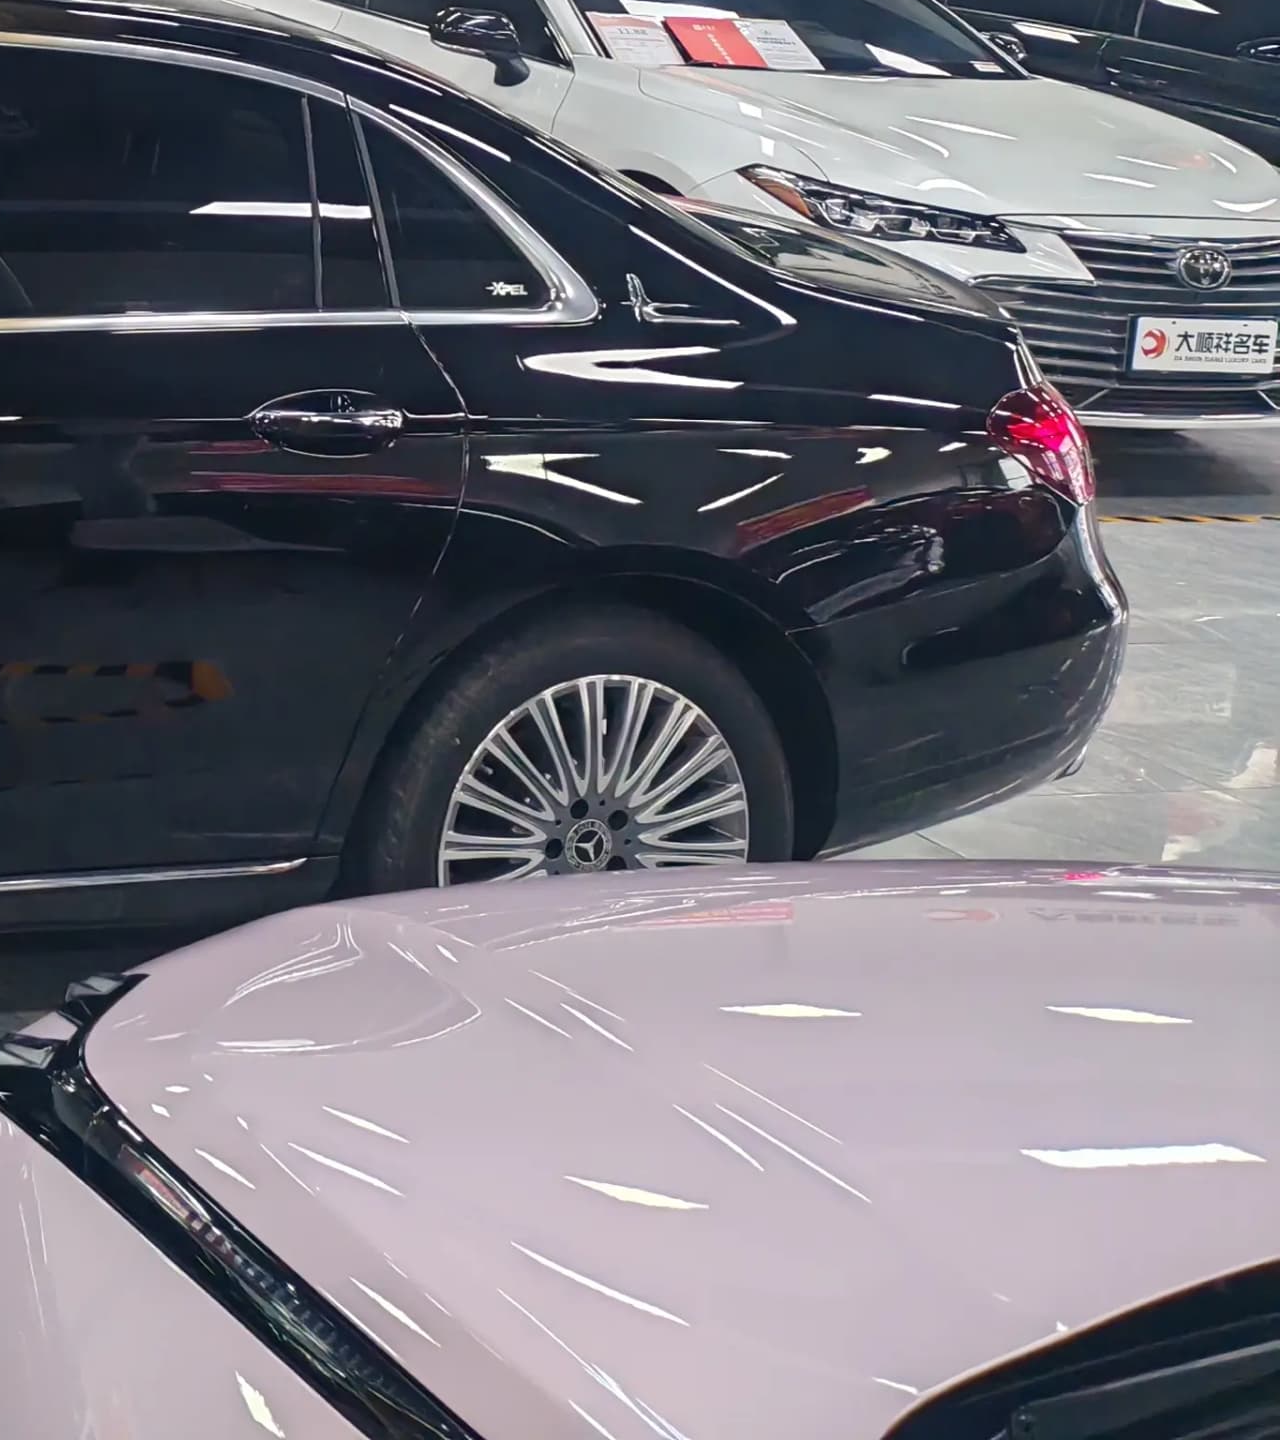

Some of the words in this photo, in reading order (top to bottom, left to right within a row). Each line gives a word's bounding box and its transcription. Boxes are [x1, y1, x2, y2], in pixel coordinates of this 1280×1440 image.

[489, 281, 528, 296] XPEL
[1175, 331, 1270, 355] 大顺祥名车
